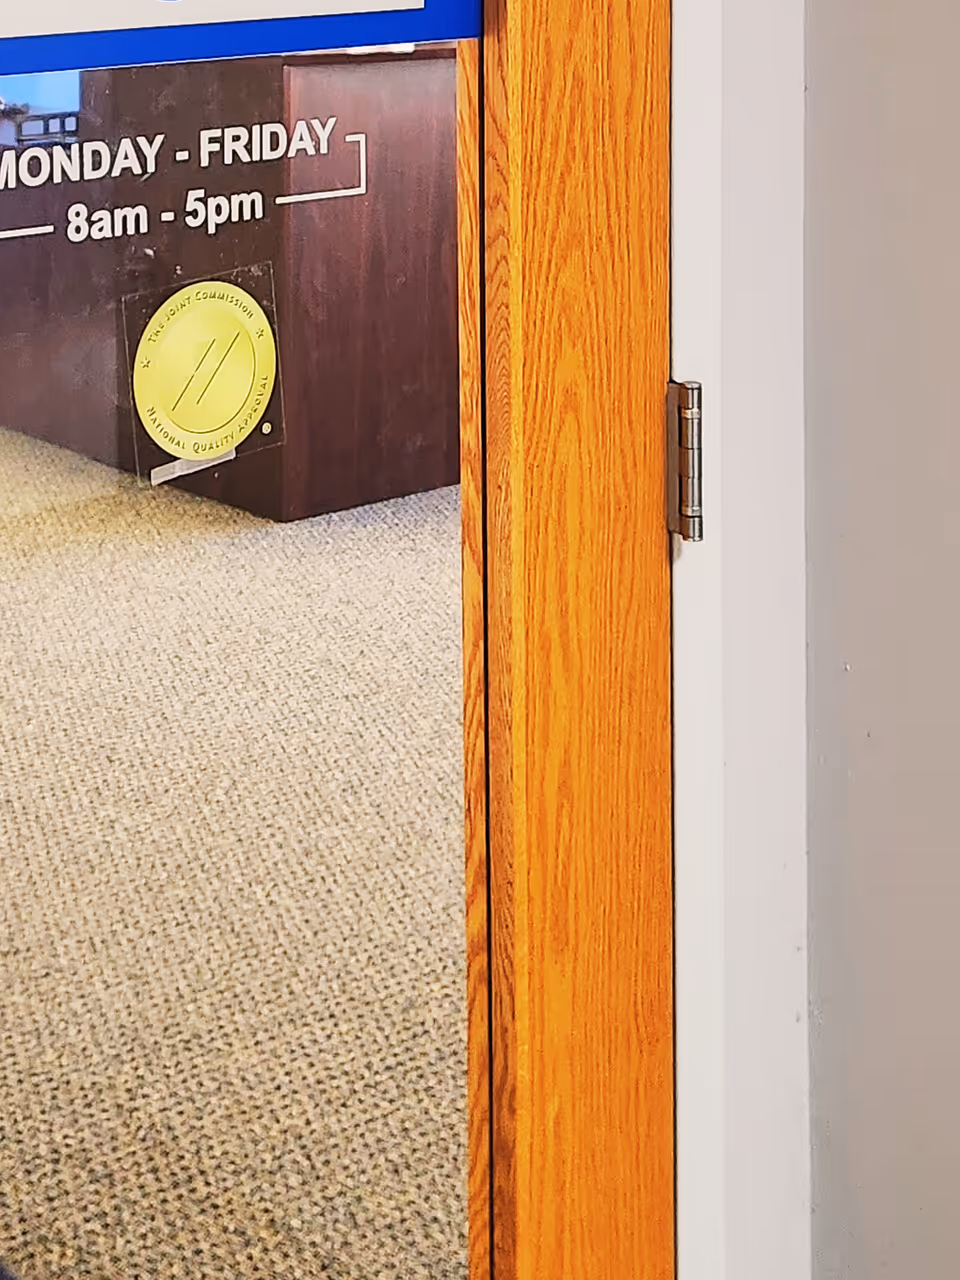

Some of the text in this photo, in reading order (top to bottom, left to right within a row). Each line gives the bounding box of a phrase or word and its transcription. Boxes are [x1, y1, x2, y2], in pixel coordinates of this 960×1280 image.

[175, 149, 189, 162] -
[199, 117, 337, 168] FRIDAY
[66, 189, 264, 243] 8am - 5pm
[148, 290, 254, 343] THE JOINT COMMISSION
[146, 375, 269, 454] NATIONAL QUALITY APPROVAL
